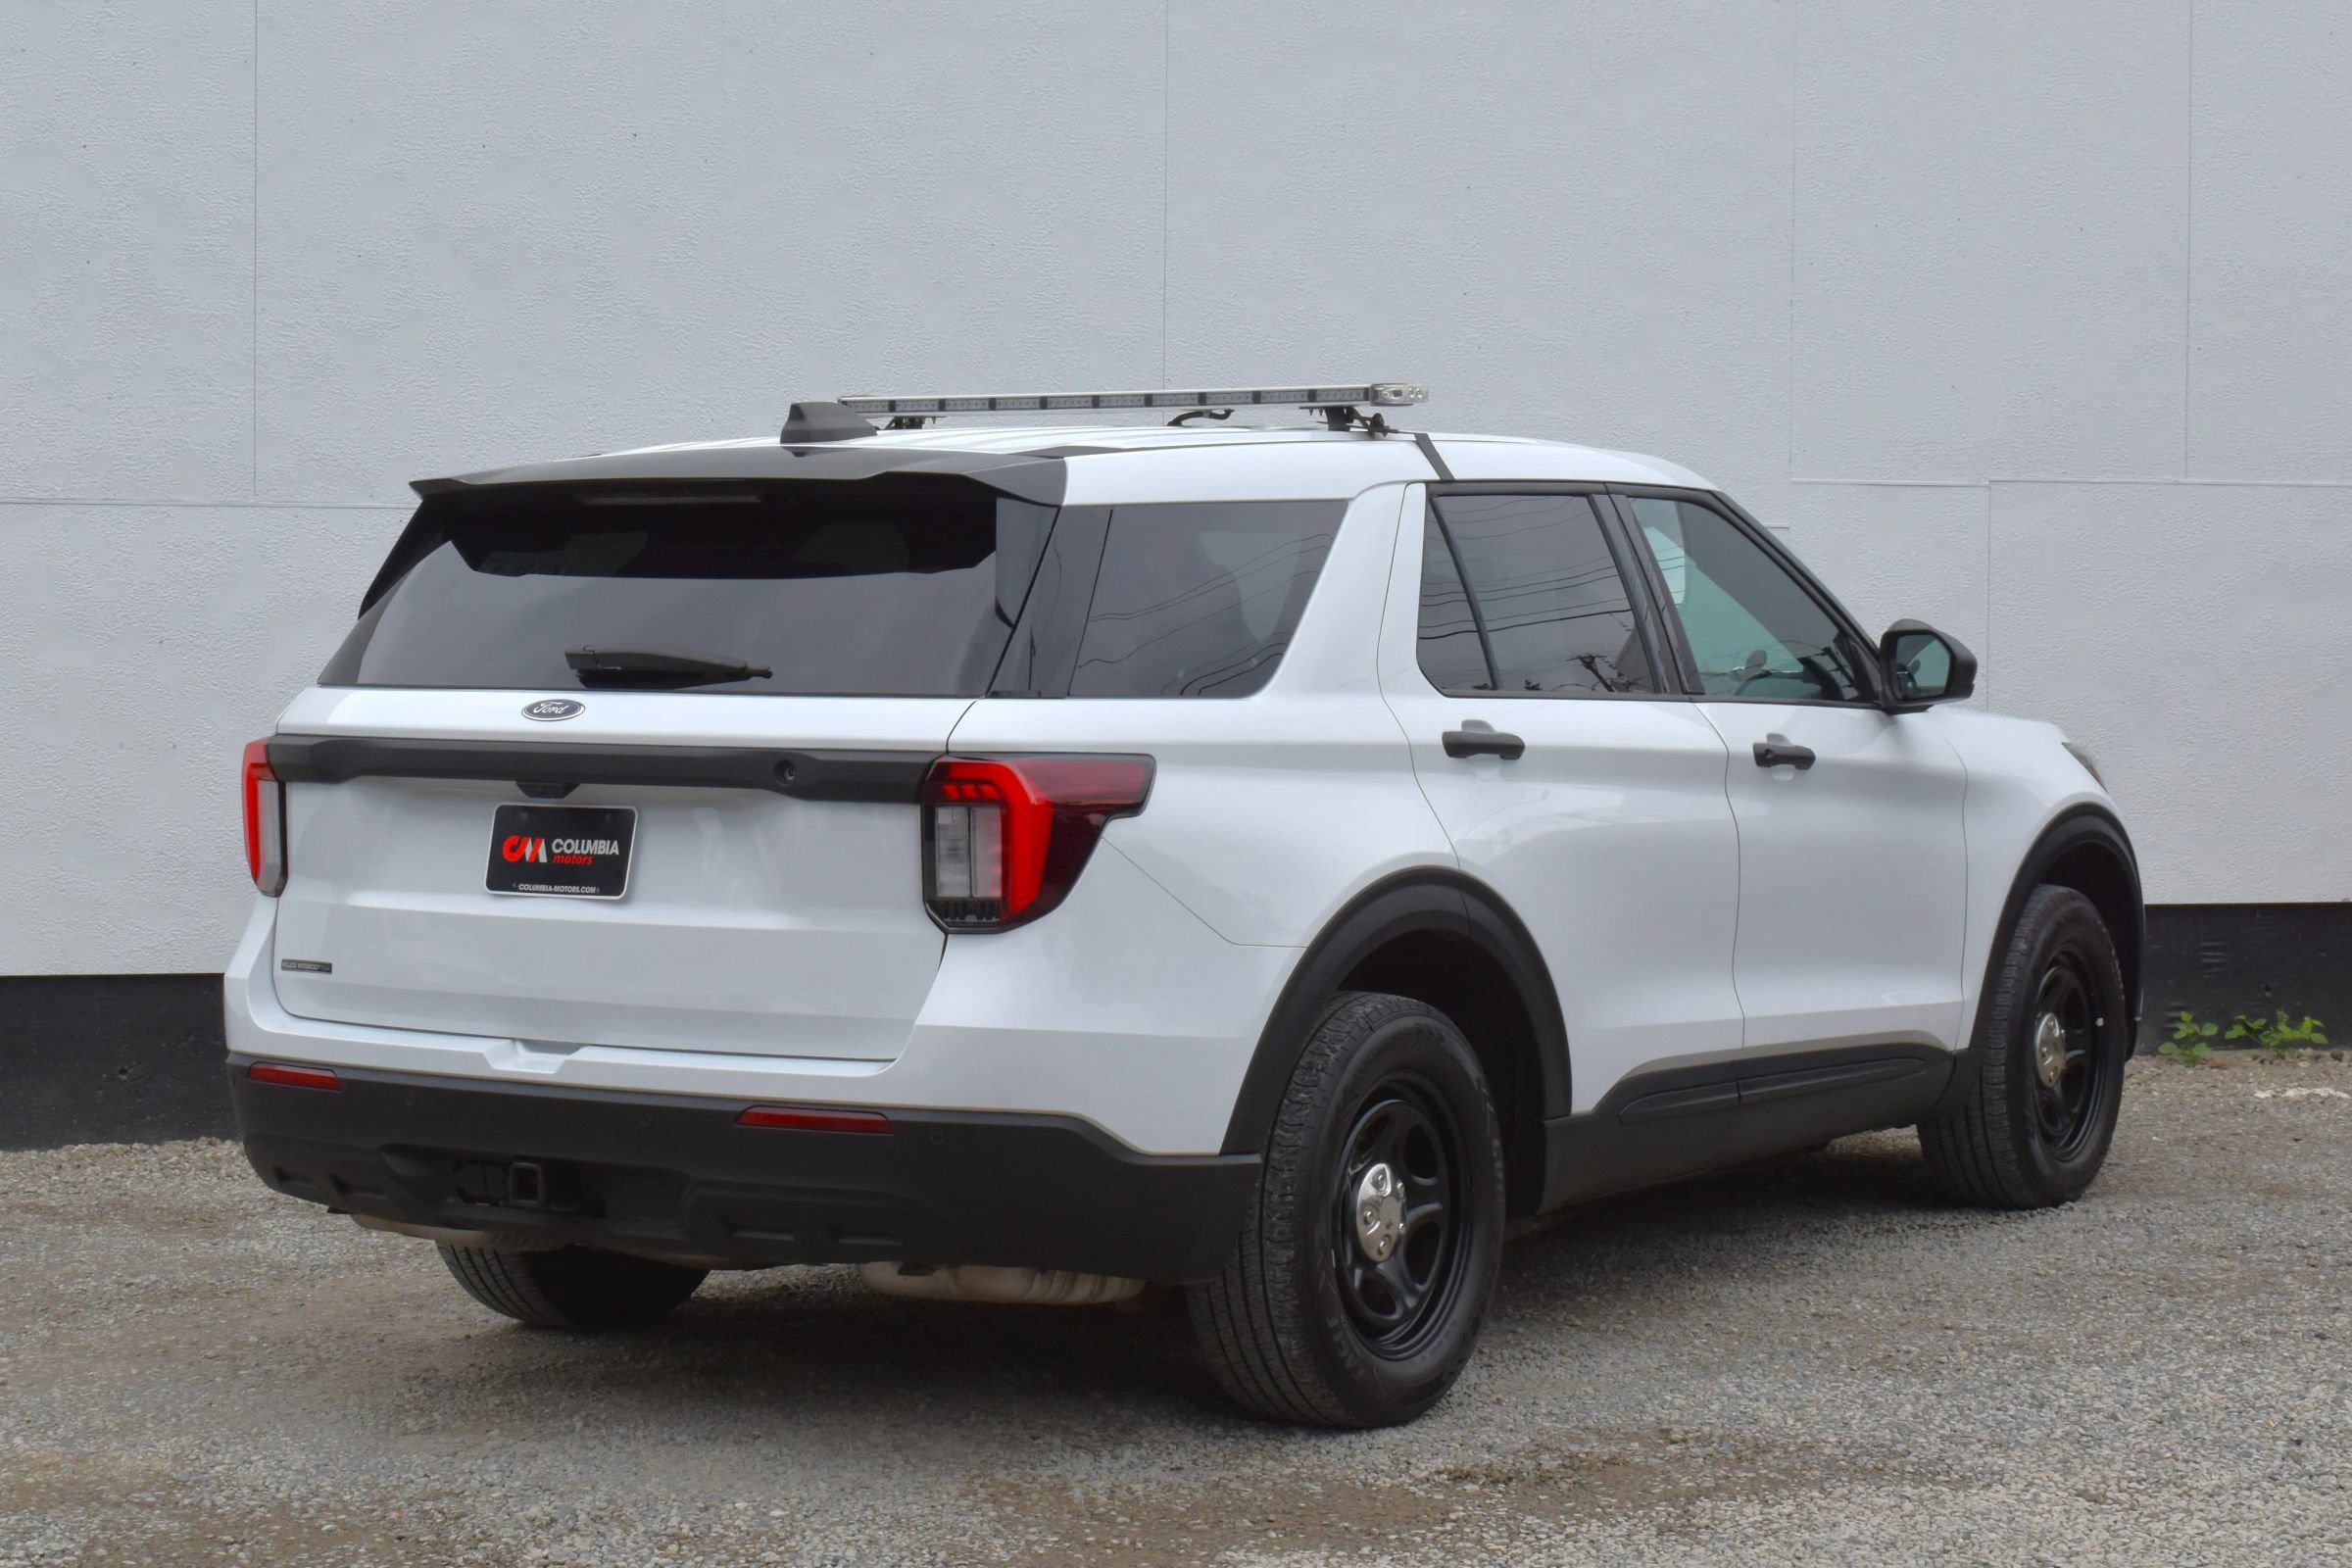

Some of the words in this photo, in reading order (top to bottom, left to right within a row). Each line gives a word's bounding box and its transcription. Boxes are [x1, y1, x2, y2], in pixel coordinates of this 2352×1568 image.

[533, 702, 569, 714] Ford
[552, 839, 619, 856] COLUMBIA
[553, 855, 593, 865] motors
[518, 883, 597, 894] COLUMBIA-MOTORS.COM
